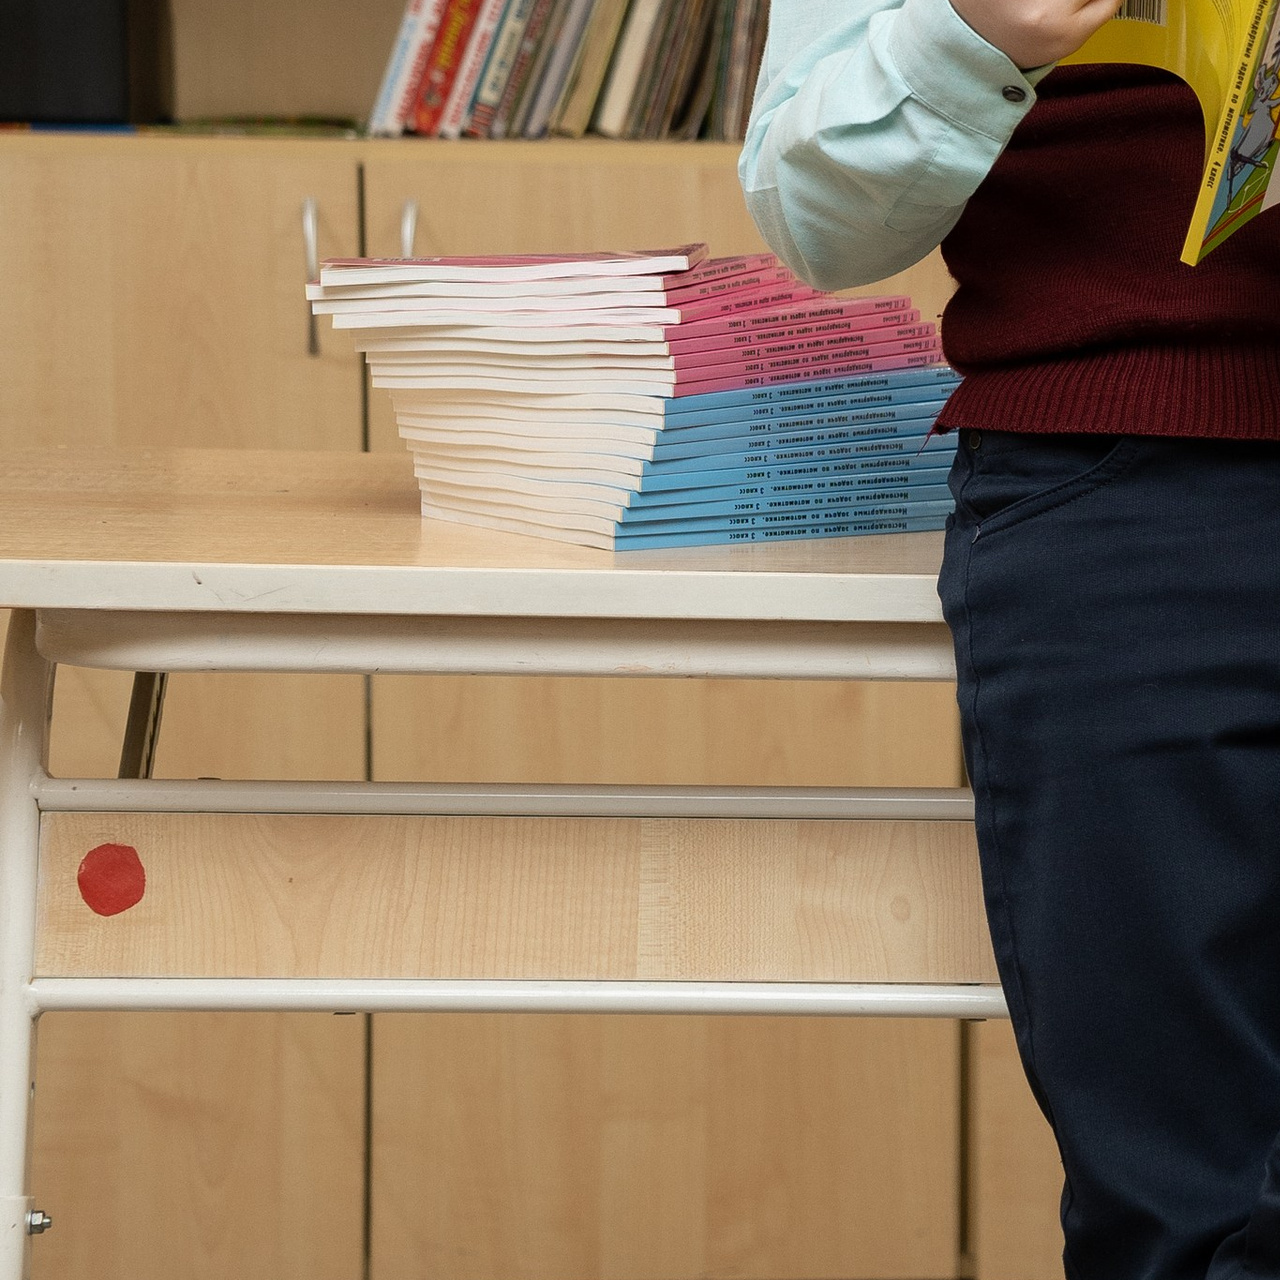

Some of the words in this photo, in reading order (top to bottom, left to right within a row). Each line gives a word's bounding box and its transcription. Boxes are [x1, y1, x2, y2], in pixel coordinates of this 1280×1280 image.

[1234, 61, 1249, 91] задачи
[1230, 93, 1239, 105] по
[1216, 108, 1235, 154] математике.
[1206, 166, 1220, 190] класс
[744, 363, 759, 371] класс
[744, 377, 759, 385] класс
[846, 379, 888, 388] Нестандартные
[824, 383, 844, 391] задачи
[826, 399, 847, 407] задачи
[849, 394, 892, 404] Нестандартные
[827, 415, 848, 423] задачи
[851, 411, 896, 421] Нестандартные
[827, 431, 849, 439] задачи
[852, 426, 898, 436] Нестандартные
[748, 440, 765, 448] класс
[854, 442, 904, 452] Нестандартные
[860, 459, 910, 468] Нестандартные
[829, 479, 854, 487] задачи
[857, 475, 909, 485] Нестандартные
[826, 495, 852, 503] задачи
[855, 492, 909, 501] Нестандартные
[823, 510, 849, 518] задачи
[853, 507, 908, 516] Нестандартные
[853, 521, 907, 531] Нестандартные
